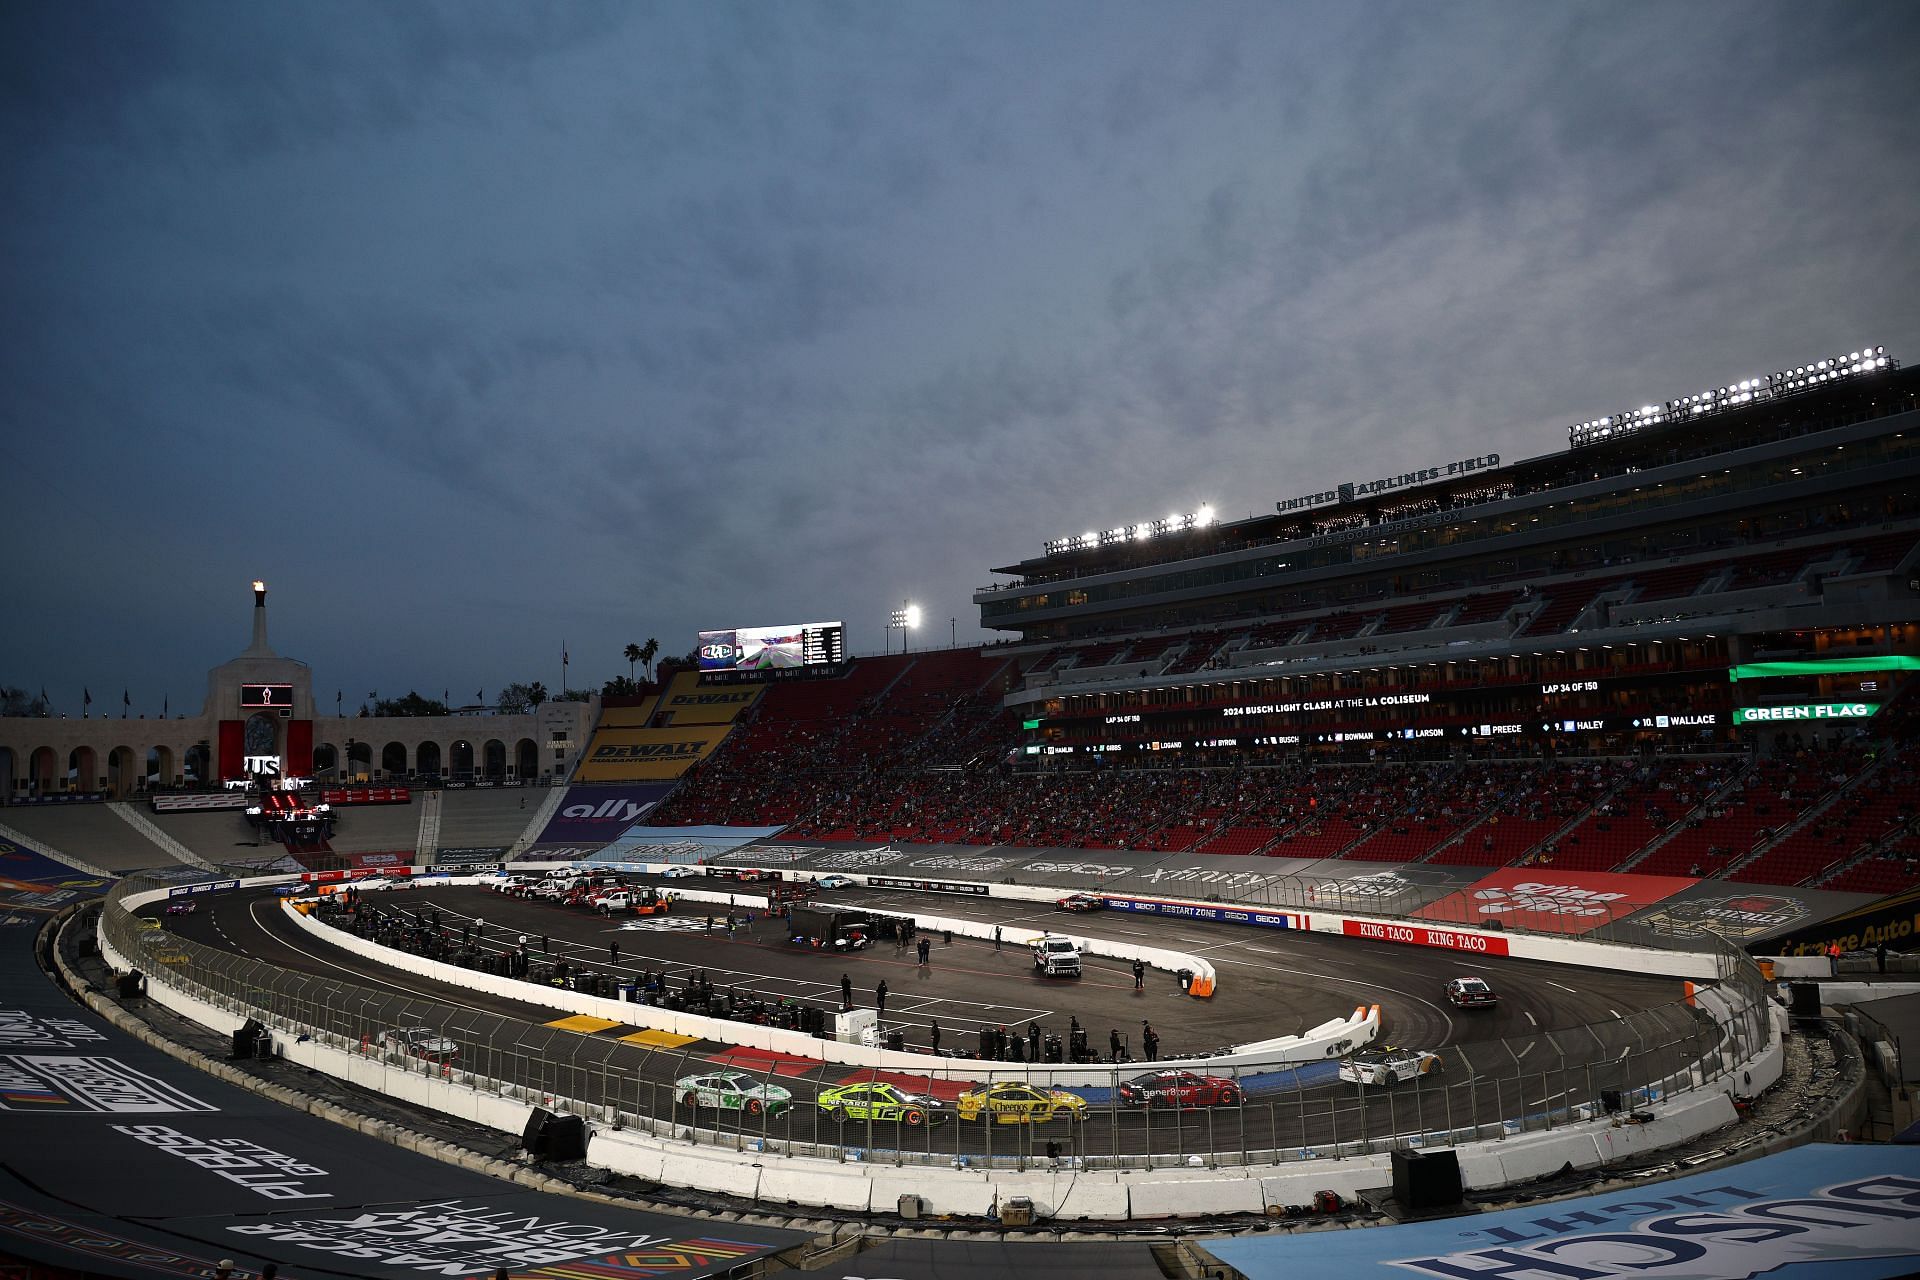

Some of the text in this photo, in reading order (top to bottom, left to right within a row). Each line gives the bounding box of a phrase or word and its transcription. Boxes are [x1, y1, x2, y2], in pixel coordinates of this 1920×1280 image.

[1276, 453, 1500, 512] UNITED AIRLINES FIELD
[1306, 511, 1462, 548] OTIS BOOTH PRESS BOX
[1542, 681, 1598, 694] LAP 34 OF 150
[1223, 694, 1430, 717] 2024 BUSCH LIGHT CLASH AT THE LA COLISEUM
[1744, 704, 1868, 721] GREEN FLAG
[1106, 716, 1117, 724] LAP
[1218, 739, 1237, 747] BYRON
[1279, 736, 1299, 744] BUSCH
[1344, 732, 1373, 741] BOWMAN
[1415, 729, 1444, 738] LARSON
[1471, 726, 1479, 735] 8.
[1492, 724, 1522, 735] PREECE
[1554, 722, 1562, 731] 9.
[1577, 720, 1604, 731] HALEY
[1642, 717, 1654, 727] 10.
[1671, 715, 1716, 726] WALLACE
[593, 742, 707, 757] DEWALT
[563, 799, 656, 821] ally
[431, 865, 461, 873] NOCO
[470, 863, 499, 871] NOCO
[1109, 900, 1129, 909] GEICO
[1134, 902, 1156, 911] GEICO
[1161, 904, 1217, 918] RESTART ZONE
[1224, 911, 1249, 921] GEICO
[1255, 914, 1280, 924] GEICO
[1359, 923, 1414, 942] KING TACO
[1427, 931, 1486, 951] KING TACO
[1861, 919, 1912, 948] Auto
[83, 1086, 159, 1105] CUP
[111, 1125, 335, 1200] PIT BOSS
[208, 1138, 330, 1176] GRILLS
[414, 1200, 672, 1248] MONTH
[1489, 1185, 1769, 1246] LIGHT
[316, 1213, 588, 1264] BLACK
[372, 1211, 627, 1255] HISTORY
[225, 1223, 496, 1276] NASCAR
[275, 1220, 528, 1268] CELEBRATES
